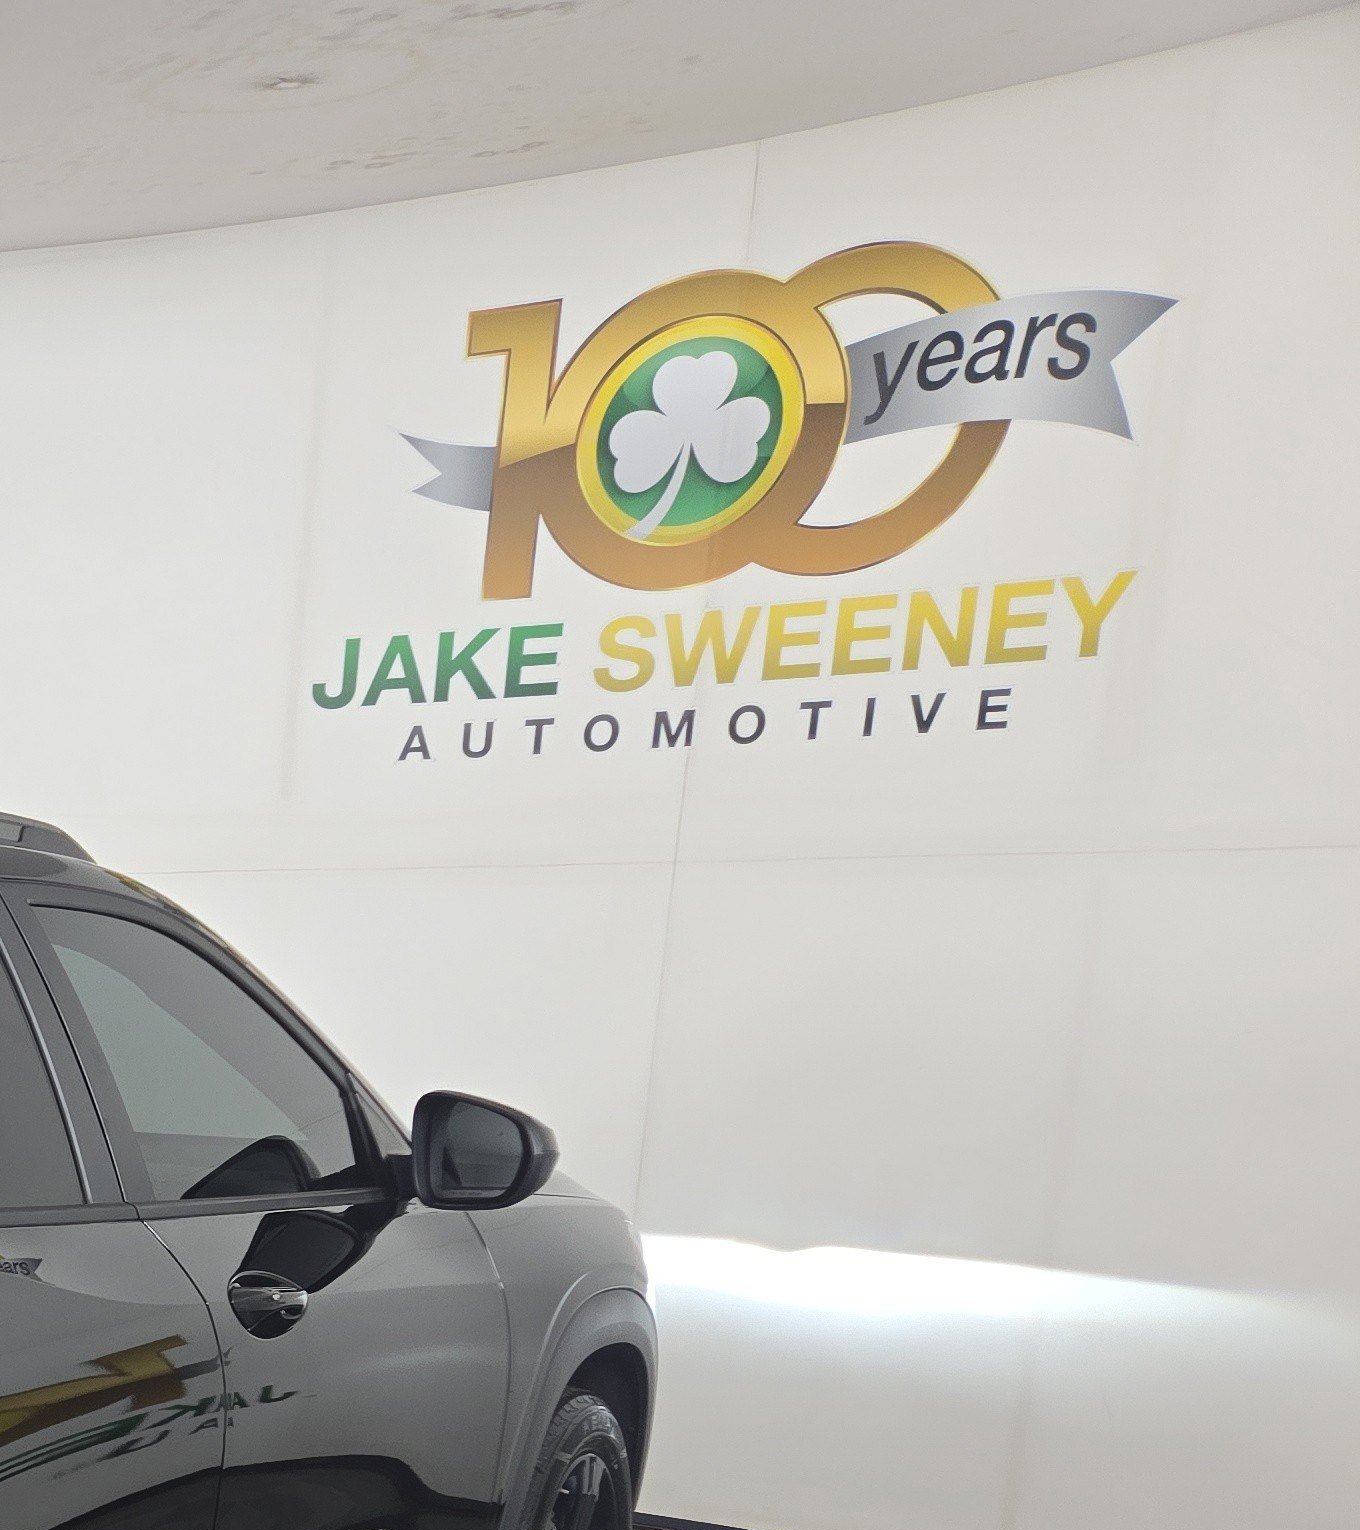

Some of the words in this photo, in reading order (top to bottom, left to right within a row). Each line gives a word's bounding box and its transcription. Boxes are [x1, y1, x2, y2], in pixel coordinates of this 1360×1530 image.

[863, 304, 1098, 425] years
[312, 622, 564, 710] JAKE
[593, 570, 1138, 693] SWEENEY
[398, 688, 1013, 761] AUTOMOTIVE
